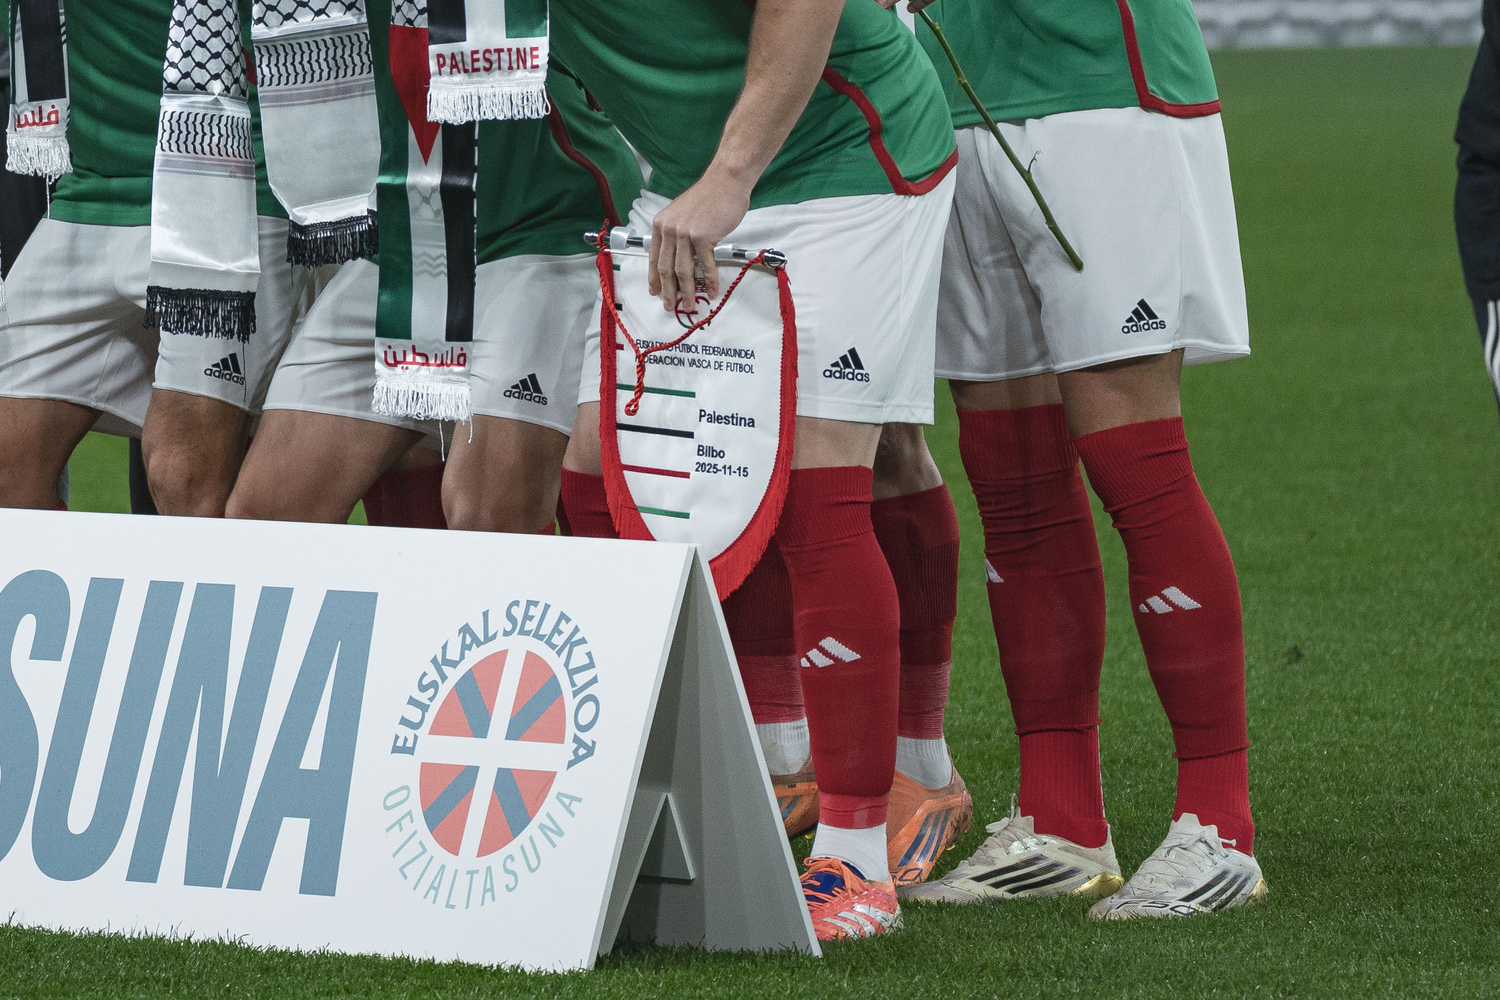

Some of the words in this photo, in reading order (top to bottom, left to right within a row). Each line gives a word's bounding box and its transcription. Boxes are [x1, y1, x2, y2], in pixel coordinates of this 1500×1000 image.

[436, 46, 540, 76] PALESTINE
[1121, 317, 1167, 334] adidas
[383, 344, 468, 371] فلسطين
[675, 343, 700, 355] FUTBOL
[701, 345, 756, 360] FEDERAKUNDEA
[687, 358, 712, 370] VASCA
[714, 360, 724, 371] DE
[725, 362, 755, 374] FUTBOL
[822, 364, 871, 383] adidas
[204, 367, 246, 386] adidas
[503, 388, 548, 406] adidas
[698, 409, 756, 428] Palestina
[697, 444, 726, 459] Bilbo
[694, 461, 749, 478] 2025-11-15
[390, 608, 499, 757] EUSKAL
[501, 599, 602, 771] SELEKZIOA
[382, 784, 584, 911] OFIZIALTASUNA
